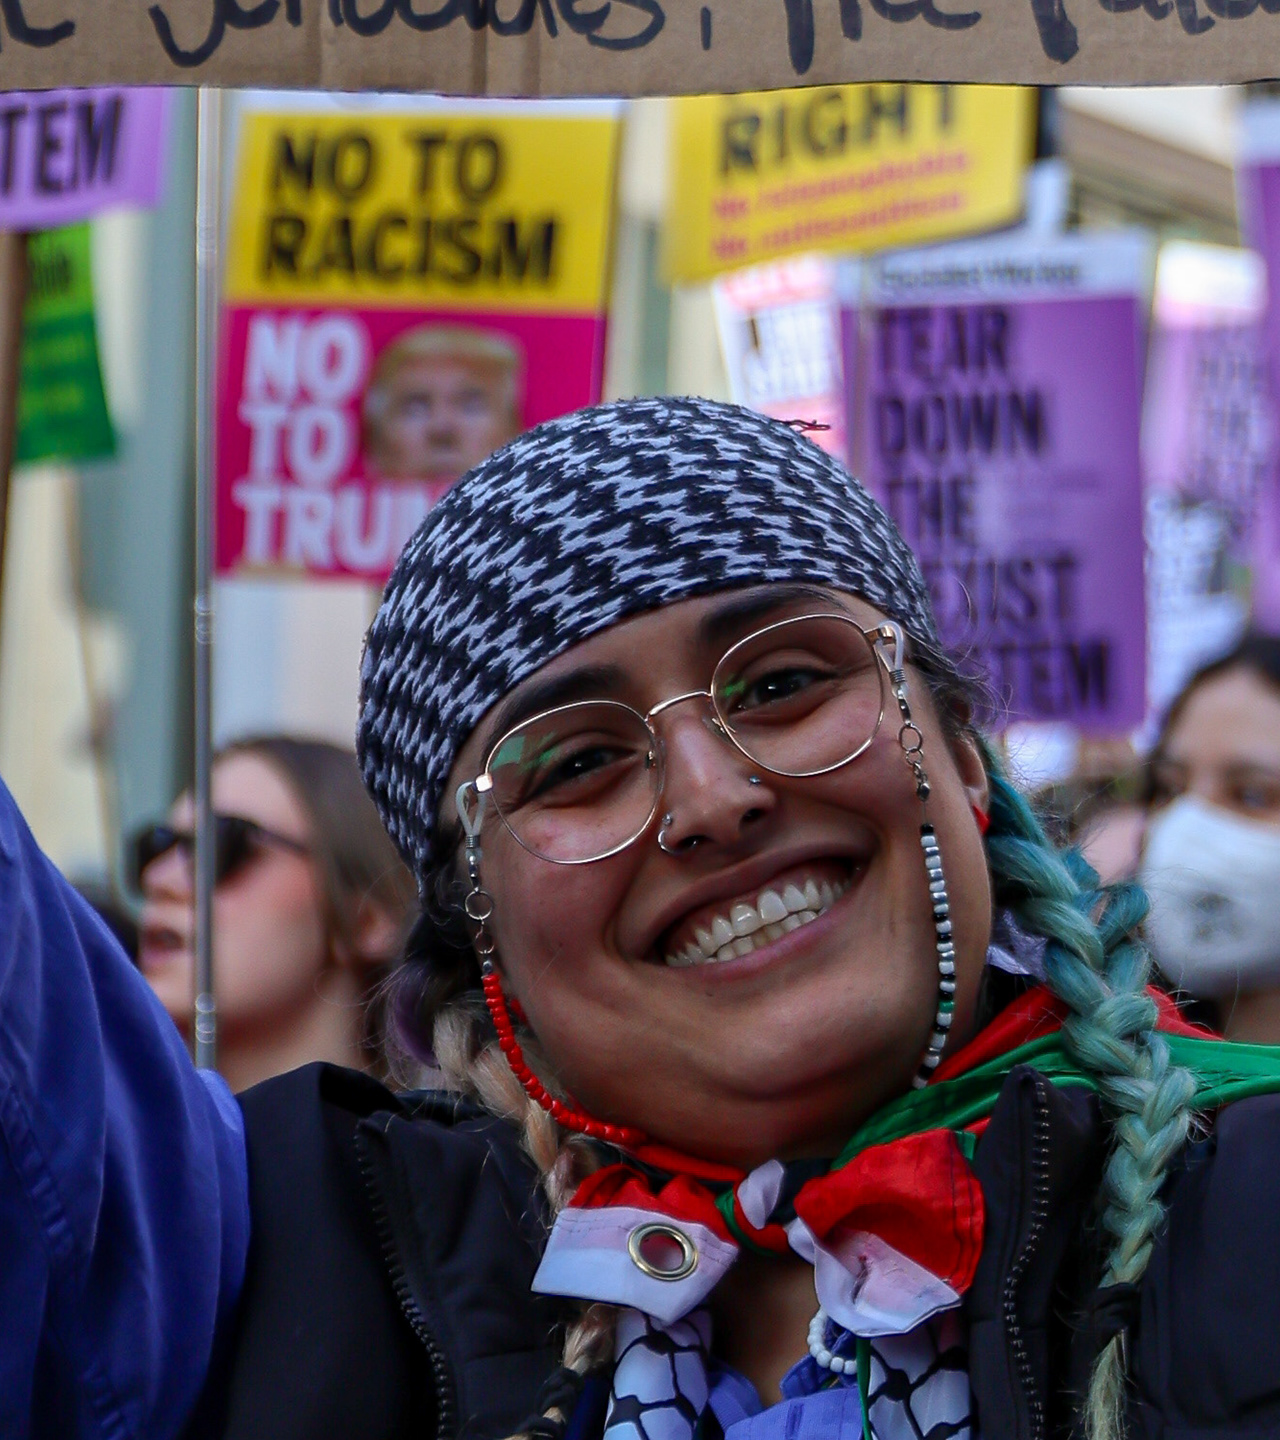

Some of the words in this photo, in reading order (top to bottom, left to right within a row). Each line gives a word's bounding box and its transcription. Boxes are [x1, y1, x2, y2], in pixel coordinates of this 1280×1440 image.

[270, 130, 373, 202] NO
[408, 130, 506, 204] TO
[260, 213, 562, 288] RACISM
[240, 313, 368, 405] NO
[236, 402, 354, 486] TO
